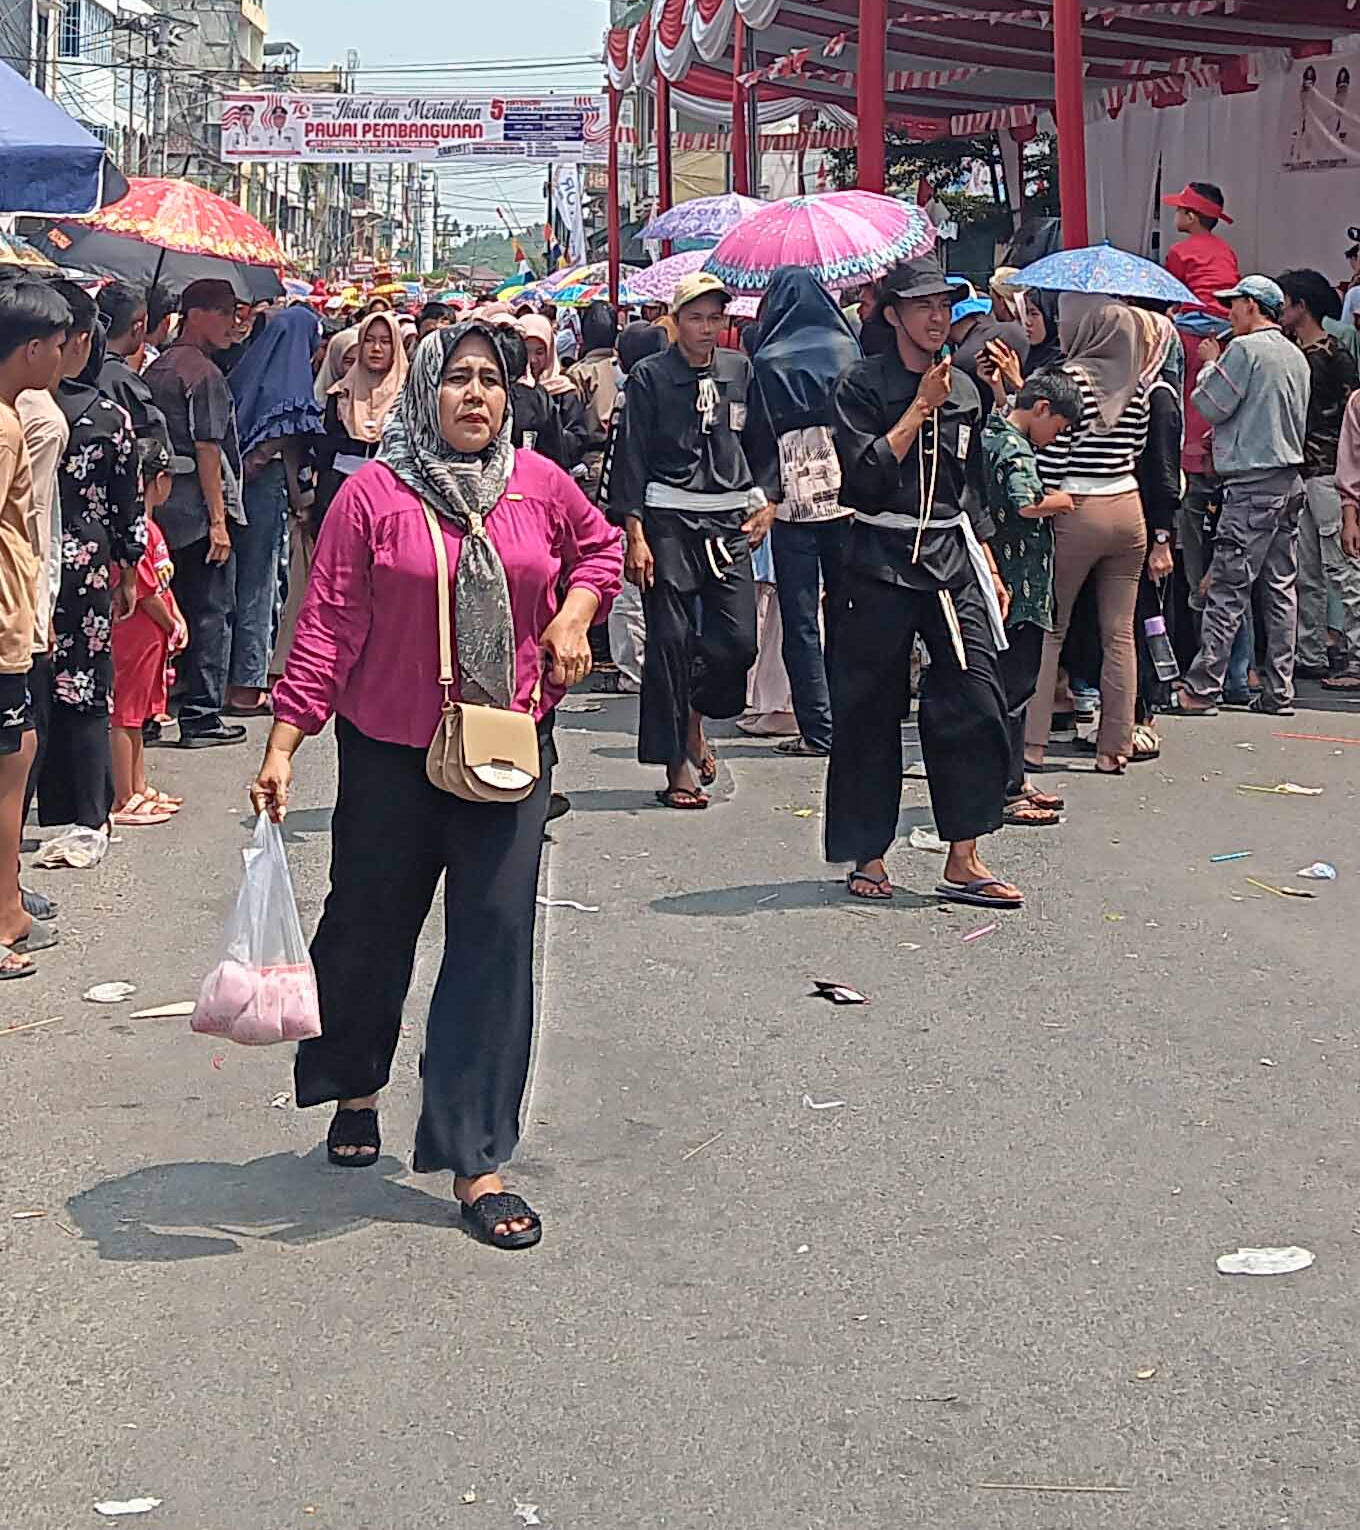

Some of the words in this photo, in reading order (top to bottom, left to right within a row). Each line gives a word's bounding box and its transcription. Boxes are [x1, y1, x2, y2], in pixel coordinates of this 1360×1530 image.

[332, 99, 370, 120] Ikuti
[374, 100, 400, 120] dan
[404, 98, 482, 121] Meriahkan
[490, 98, 505, 121] 5
[304, 122, 358, 138] PAWAI
[362, 122, 483, 139] PEMBANGUNAN
